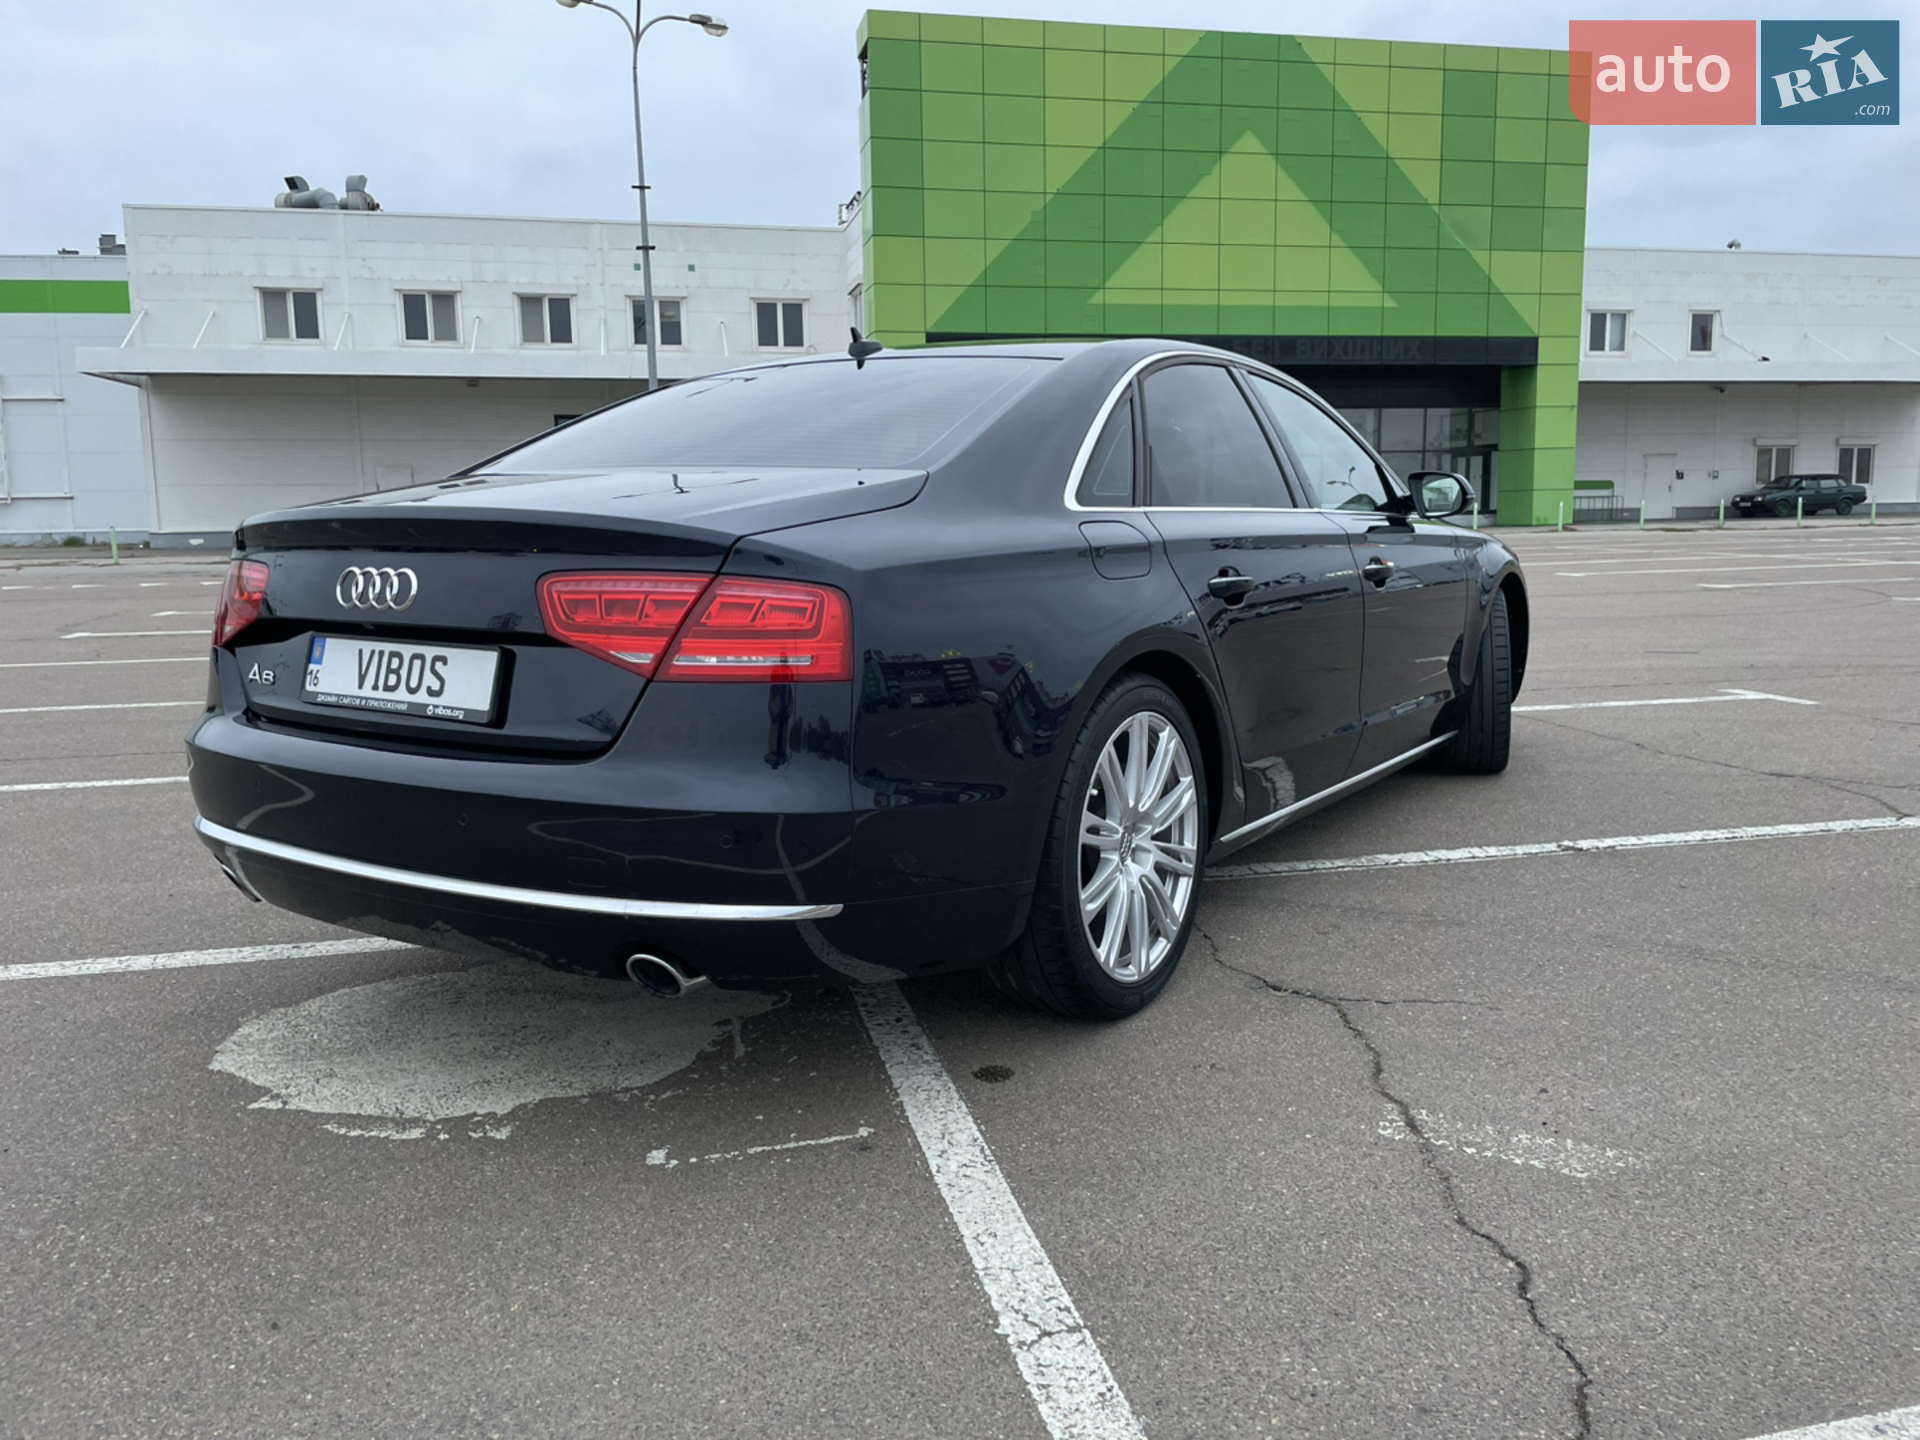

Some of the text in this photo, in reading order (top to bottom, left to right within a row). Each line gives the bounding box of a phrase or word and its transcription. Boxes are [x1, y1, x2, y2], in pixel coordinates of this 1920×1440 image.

[1296, 338, 1422, 360] ВИХІДНИХ
[248, 662, 275, 685] A8
[307, 668, 320, 687] 16
[357, 647, 449, 698] VIBOS
[316, 694, 338, 703] ДИЗАЙН
[338, 695, 361, 705] САЙТОВ
[367, 699, 408, 710] ПРИЛОЖЕНИЙ
[434, 706, 465, 719] vibos.org
